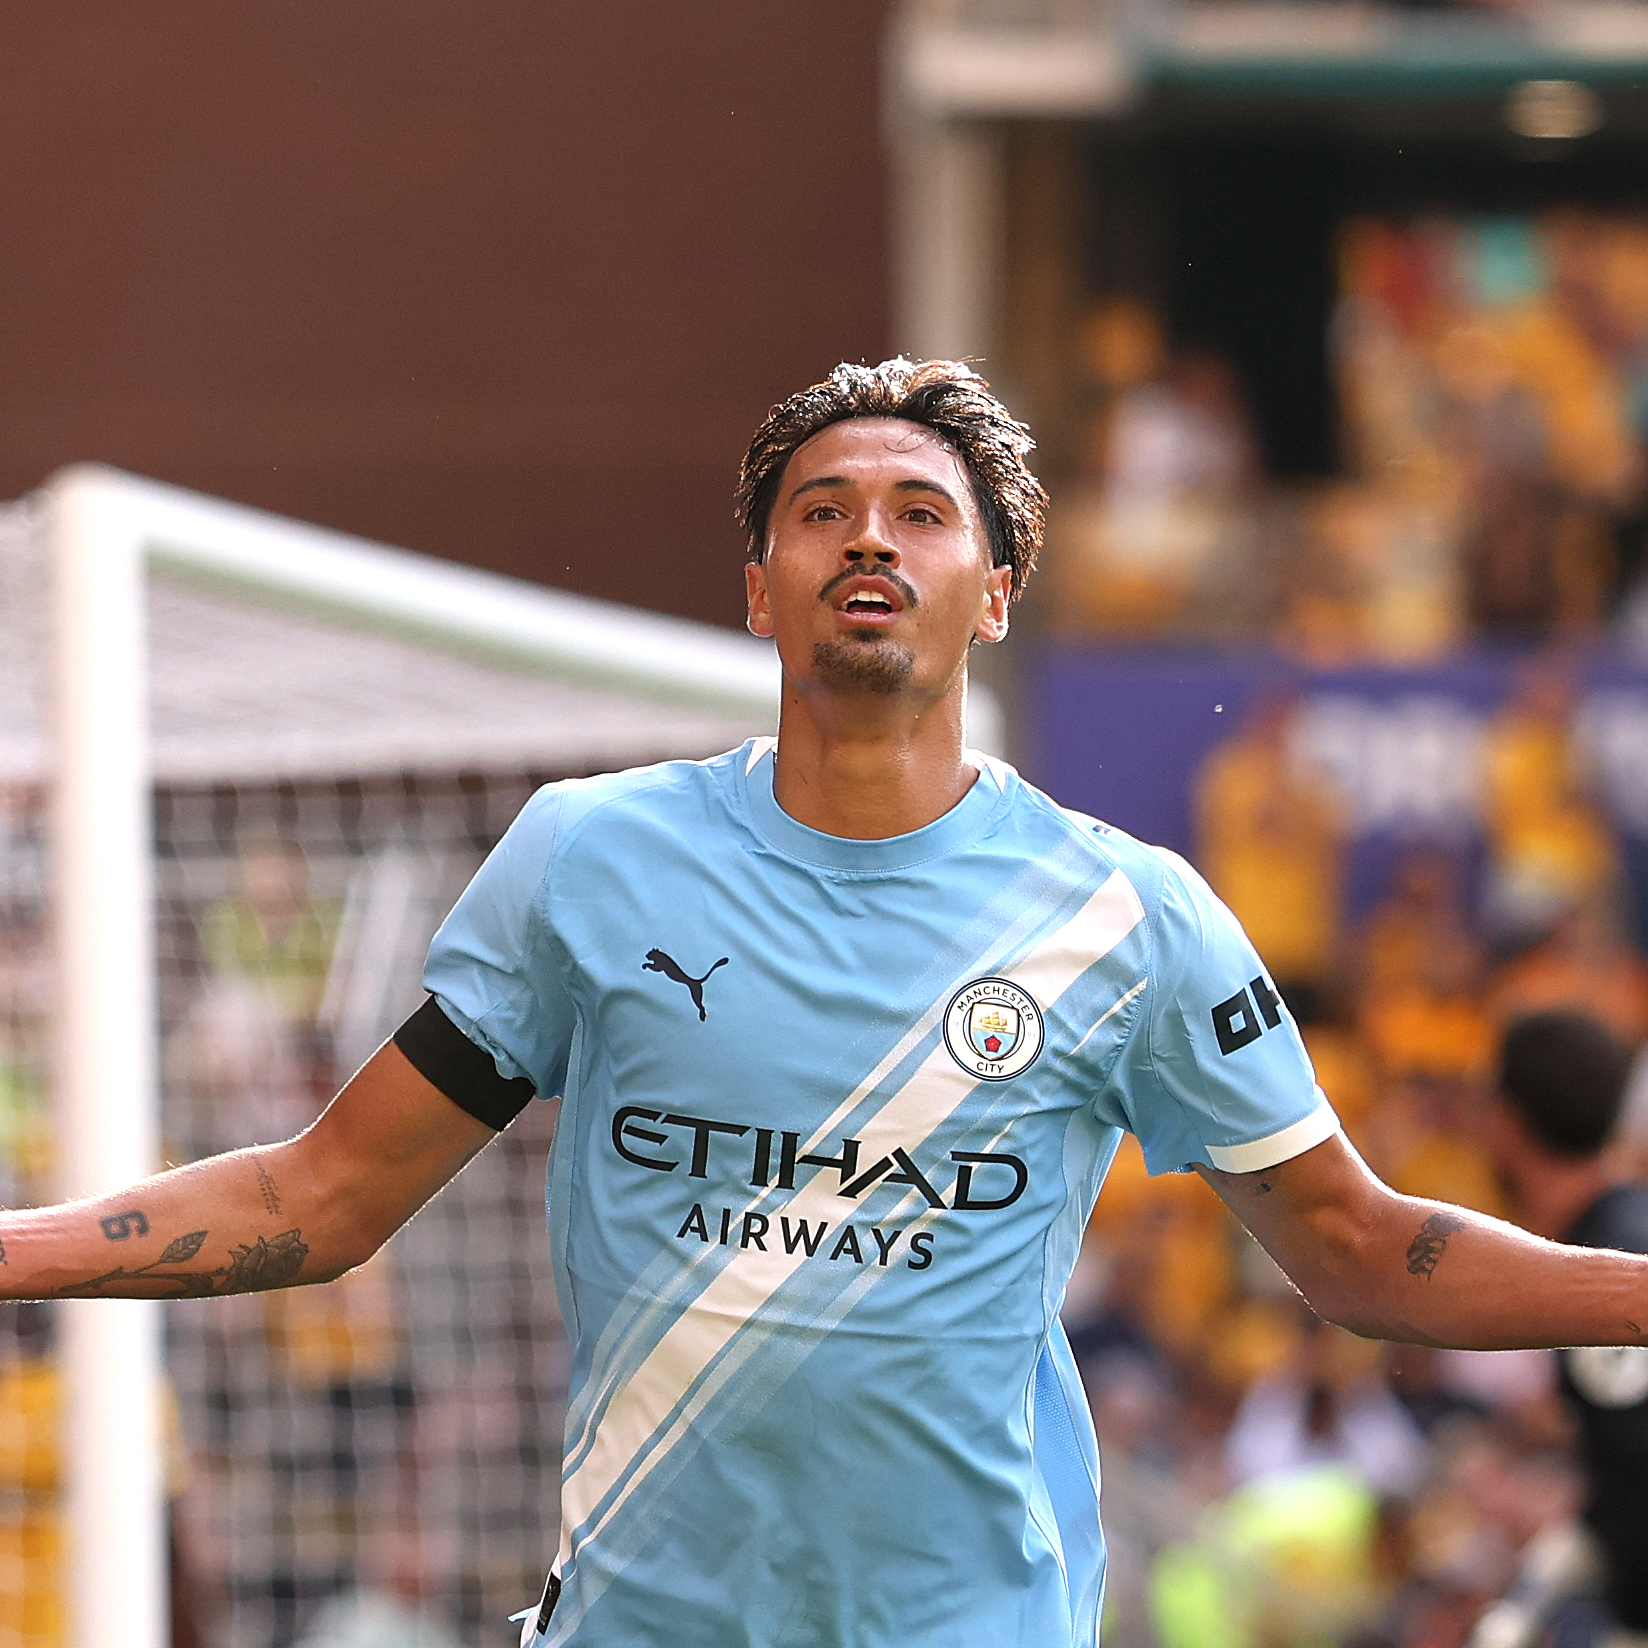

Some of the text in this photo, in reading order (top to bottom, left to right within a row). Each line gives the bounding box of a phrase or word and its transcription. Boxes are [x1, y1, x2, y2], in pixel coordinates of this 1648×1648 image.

[956, 985, 1034, 1022] MANCHESTER
[976, 1061, 1005, 1074] CITY
[611, 1105, 1028, 1211] ETIHAD
[676, 1203, 935, 1271] AIRWAYS
